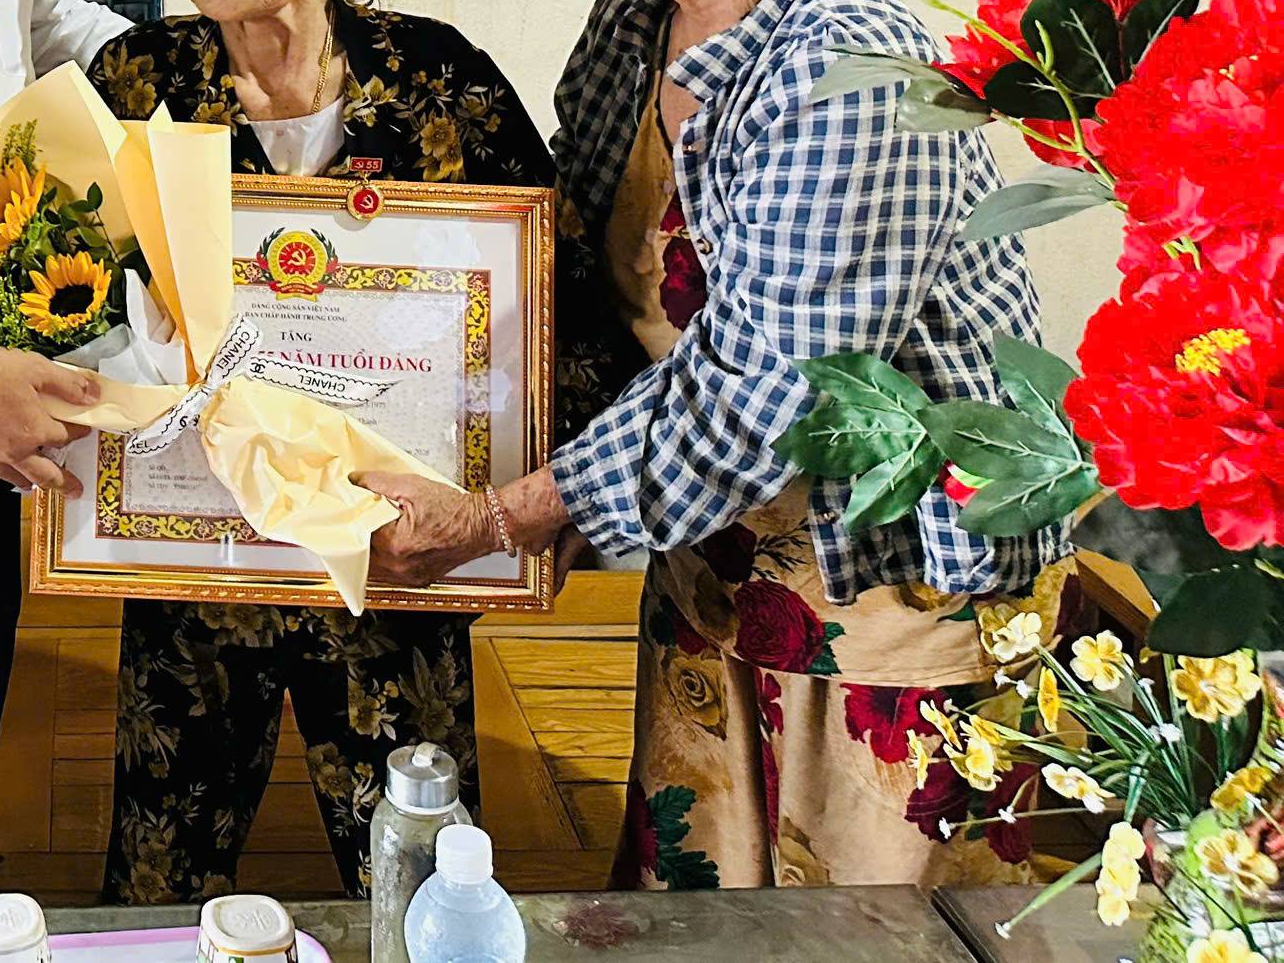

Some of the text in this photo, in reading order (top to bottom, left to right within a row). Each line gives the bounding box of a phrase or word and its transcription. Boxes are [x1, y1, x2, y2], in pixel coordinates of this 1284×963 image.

[366, 160, 379, 170] 55
[216, 331, 251, 370] CHANEL
[280, 348, 432, 373] NĂM TUỔI ĐẢNG
[299, 374, 346, 392] CHANEL
